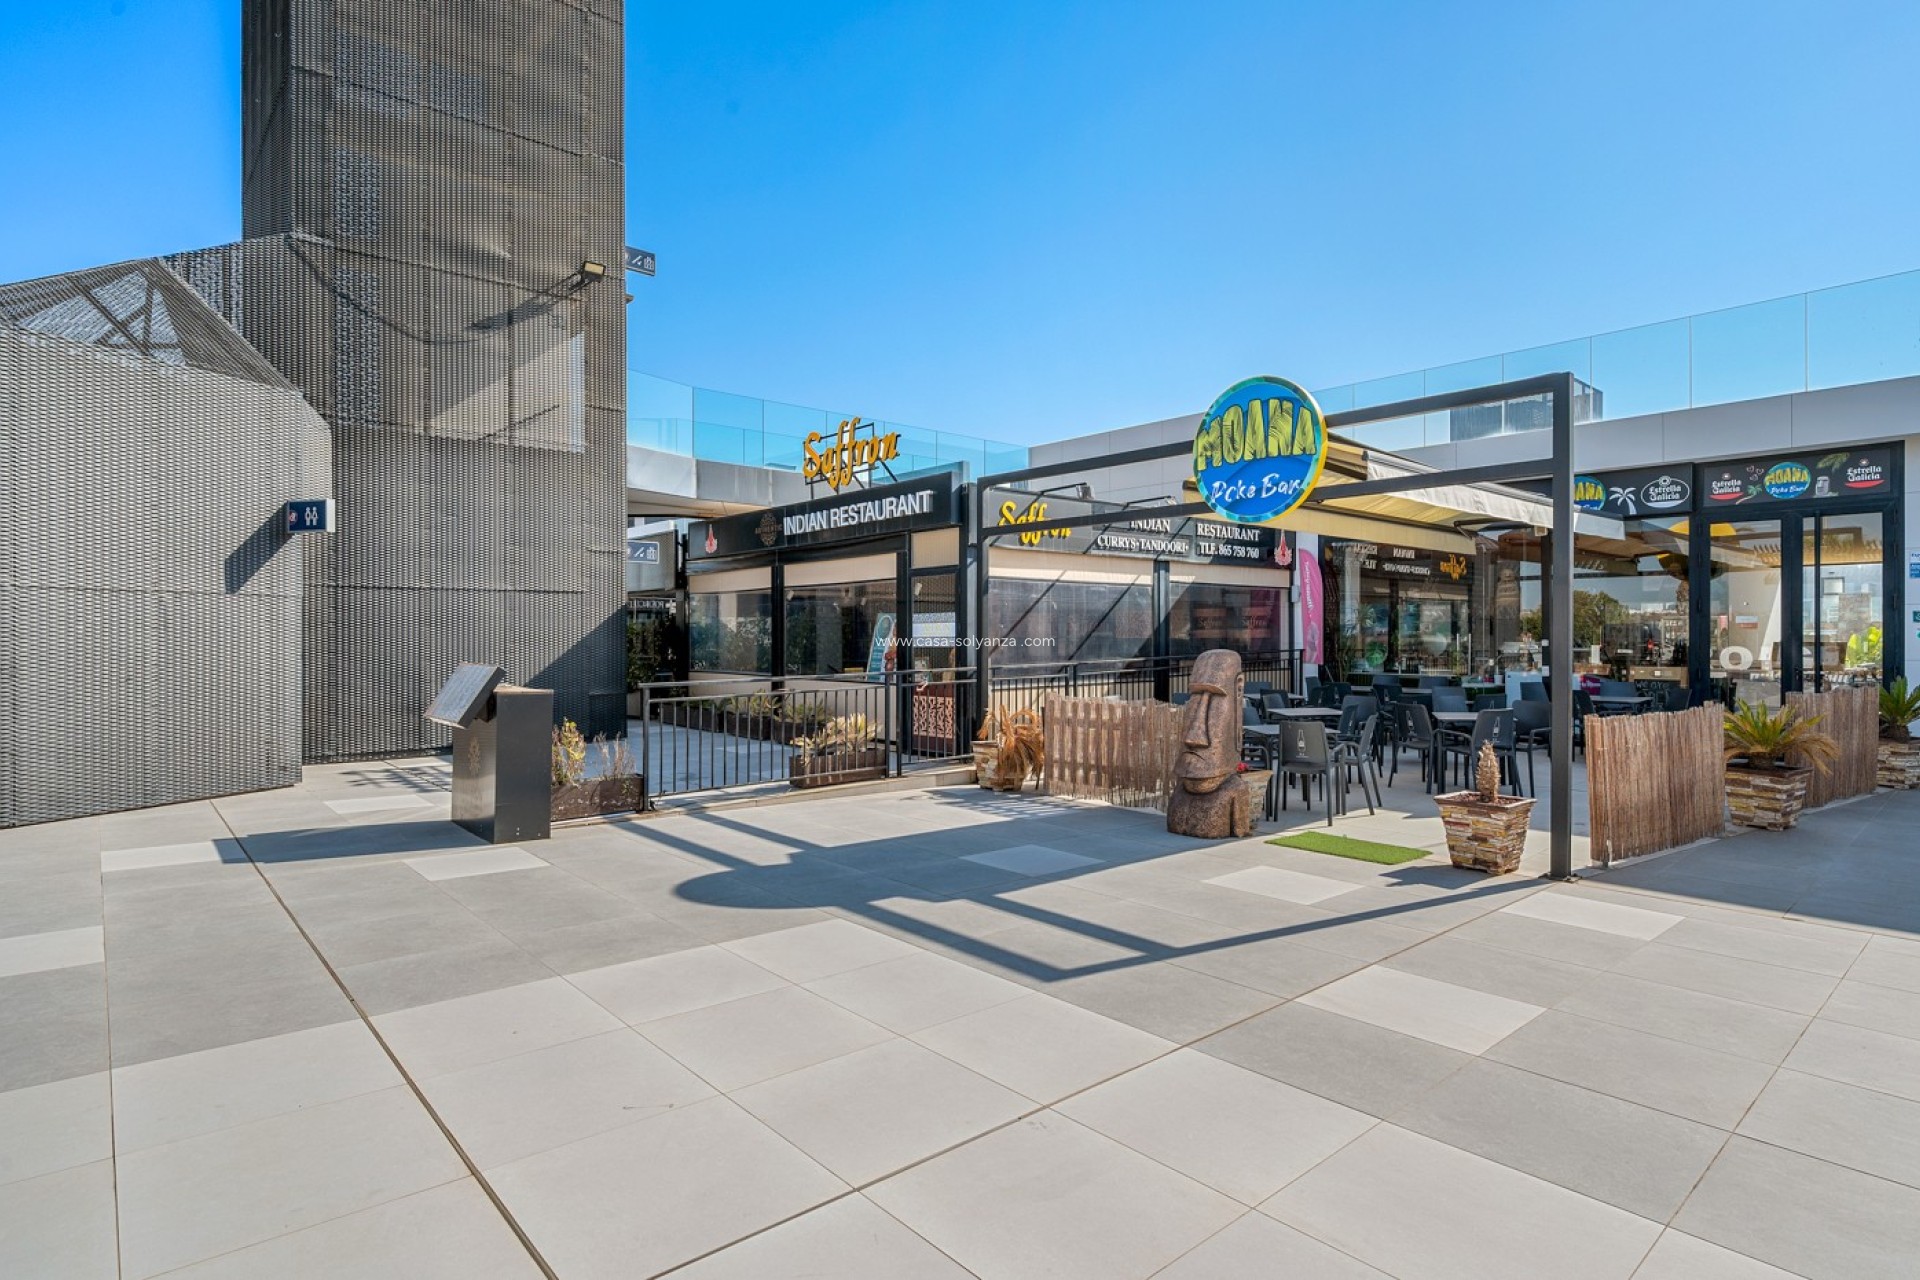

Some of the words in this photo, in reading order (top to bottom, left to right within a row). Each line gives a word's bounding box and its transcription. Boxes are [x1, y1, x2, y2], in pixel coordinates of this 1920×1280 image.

[1197, 398, 1317, 471] MOANA
[802, 417, 899, 490] Saffron
[1765, 467, 1809, 486] MOANA
[1847, 465, 1882, 477] Estrella
[1848, 472, 1881, 482] Galicia
[1261, 473, 1304, 499] Bar
[1575, 482, 1604, 501] ANA
[1648, 485, 1682, 495] Estrella
[1712, 479, 1742, 489] Estrella
[783, 508, 830, 535] INDIAN
[830, 490, 933, 528] RESTAURANT
[998, 501, 1072, 544] Saffon
[1130, 518, 1171, 533] INDIAN
[1197, 523, 1260, 541] RESTAURANT
[1219, 544, 1232, 556] 865
